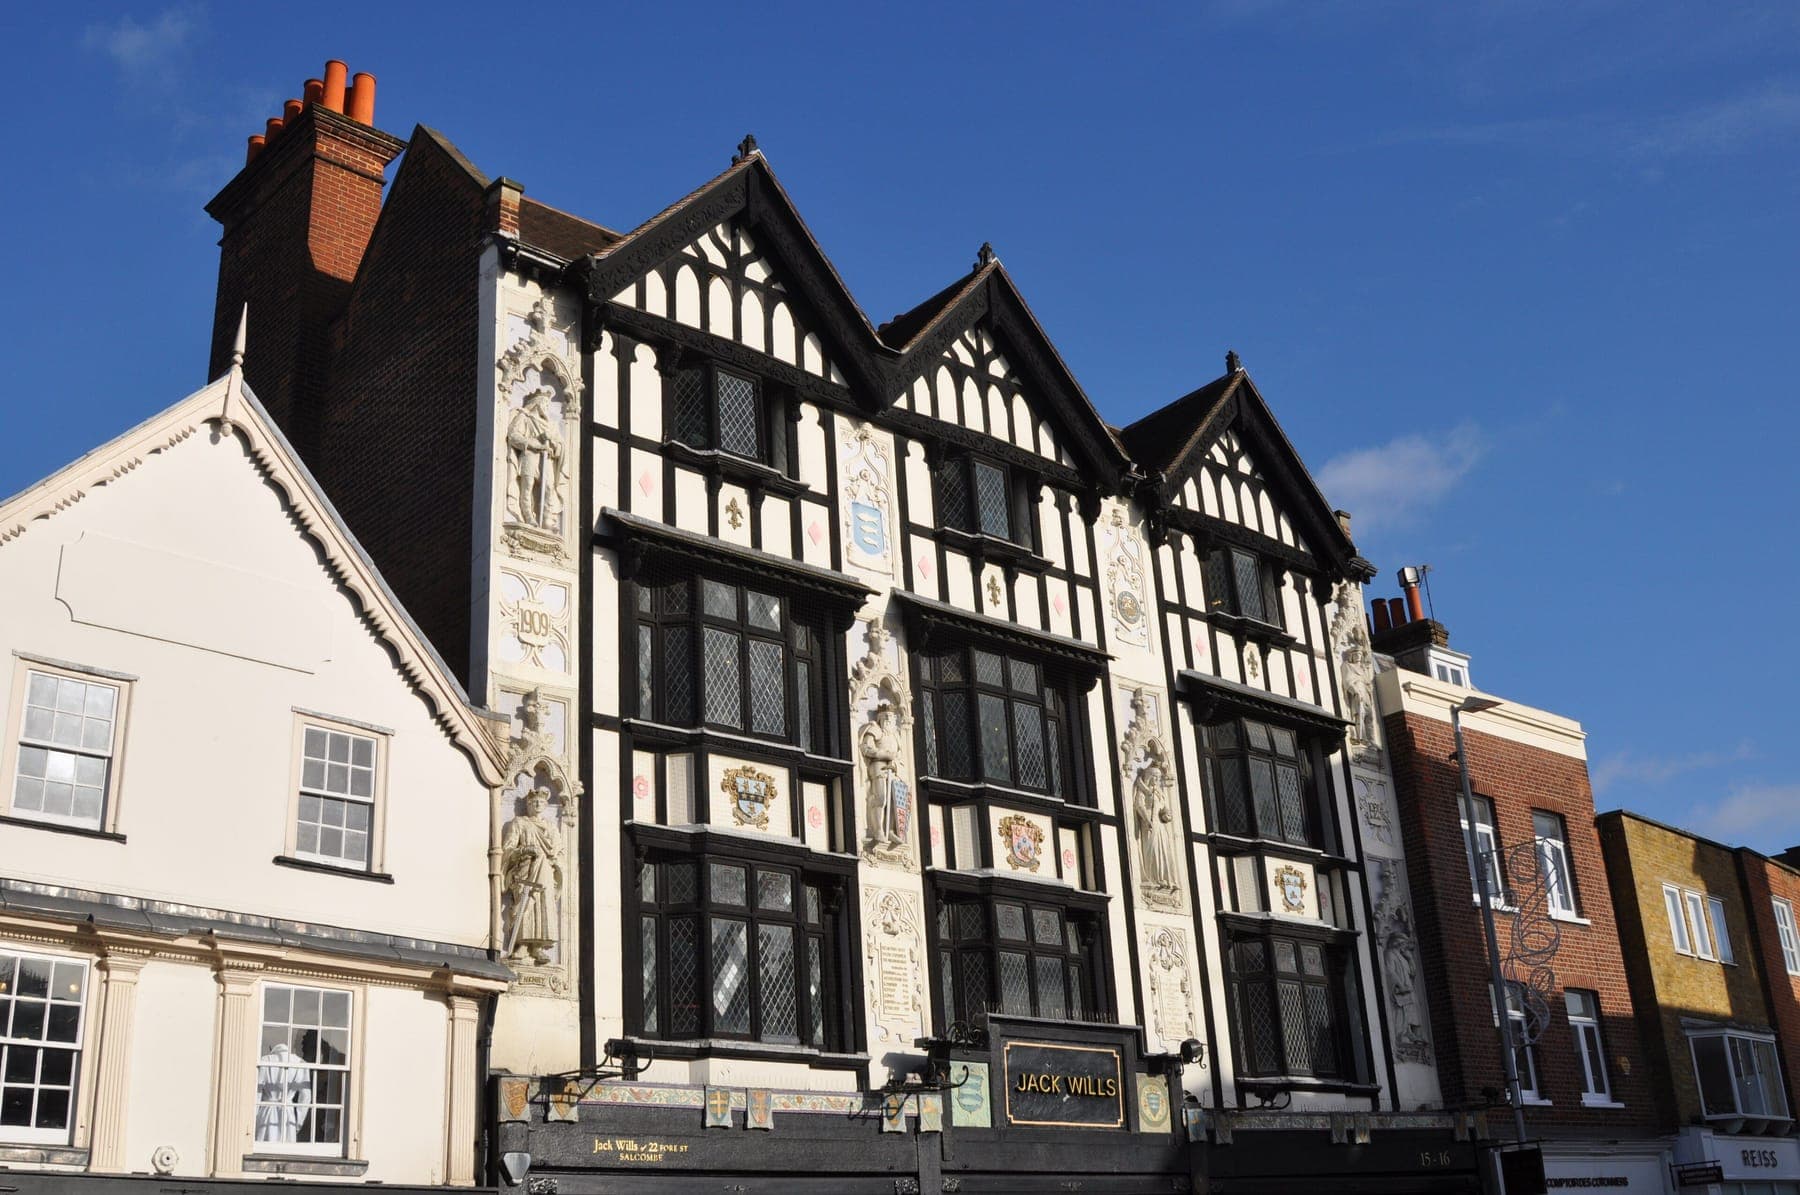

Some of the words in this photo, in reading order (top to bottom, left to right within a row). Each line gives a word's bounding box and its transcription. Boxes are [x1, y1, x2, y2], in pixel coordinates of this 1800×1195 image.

[520, 608, 548, 636] 1909
[1017, 1073, 1061, 1093] JACK
[1068, 1075, 1116, 1097] WILLS
[593, 1139, 613, 1153] Jack
[615, 1139, 638, 1151] Wills
[648, 1142, 658, 1152] 22
[619, 1153, 663, 1161] SALCOMBE
[1741, 1149, 1778, 1168] REISS
